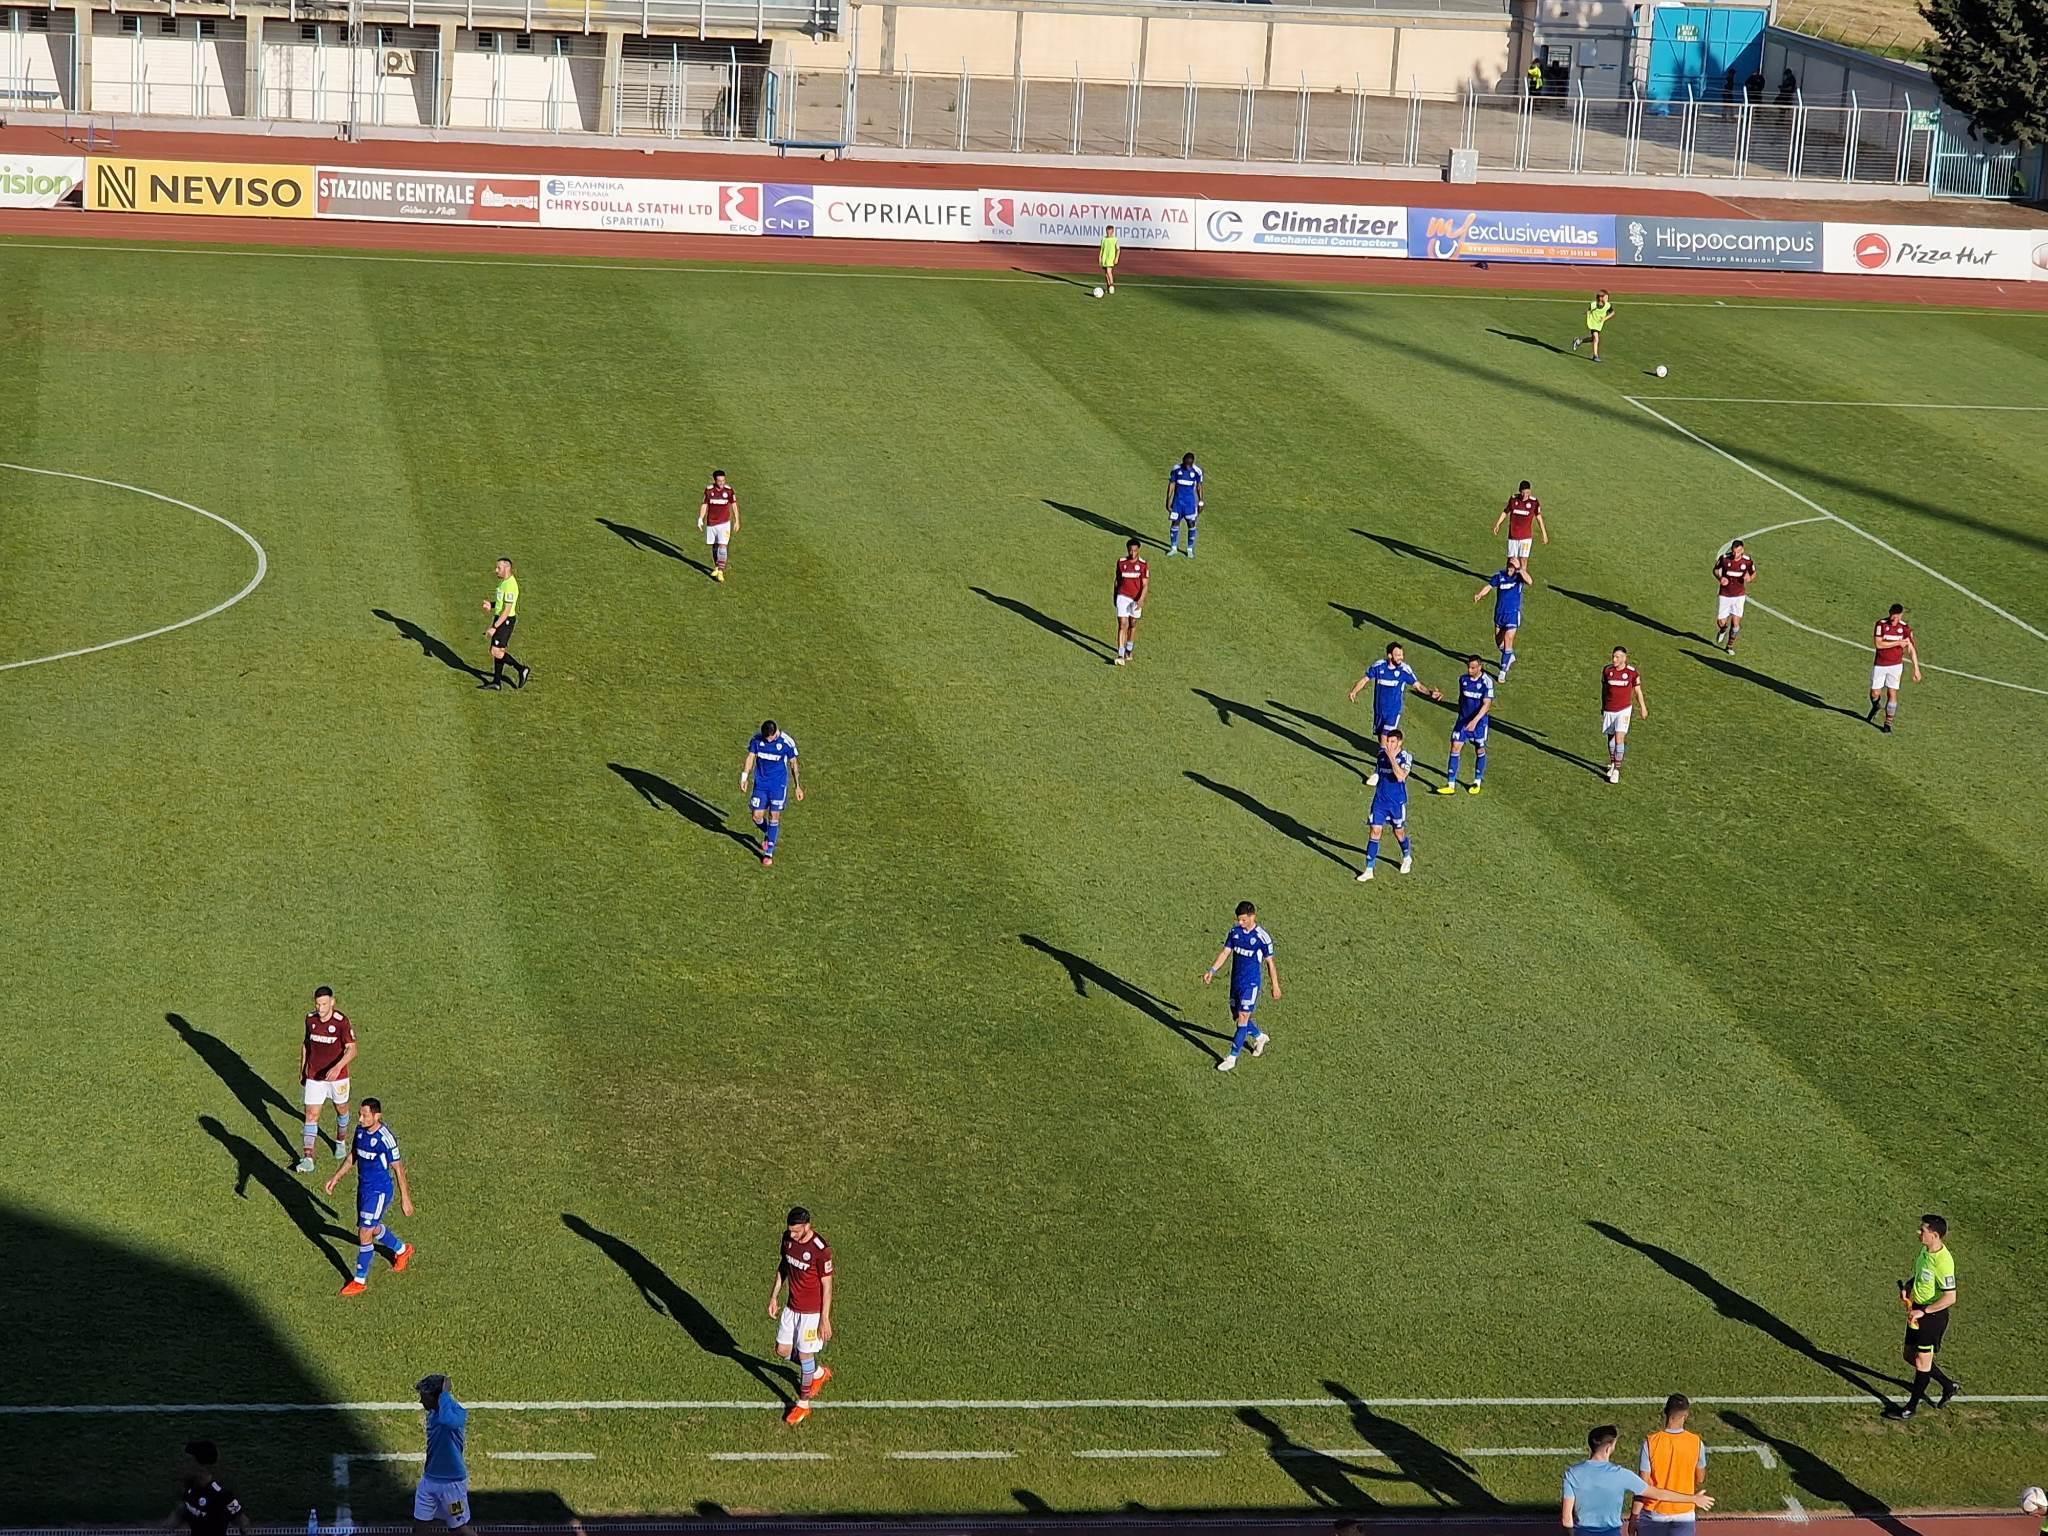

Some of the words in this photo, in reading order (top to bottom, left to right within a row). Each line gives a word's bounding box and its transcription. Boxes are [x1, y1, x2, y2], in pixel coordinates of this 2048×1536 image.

[0, 166, 72, 195] ision
[567, 180, 625, 191] ΕΛΛΗΝΙΚΑ
[150, 174, 302, 208] NEVISO
[319, 177, 393, 201] STAZIONE
[396, 182, 475, 205] CENTRALE
[546, 199, 633, 213] CHRYSOULLA
[638, 202, 684, 215] STATHI
[688, 204, 713, 216] LTD
[828, 201, 972, 227] CYPRIALIFE
[1020, 202, 1065, 218] Α/ΦΟΙ
[1069, 204, 1153, 222] ΑΡΤΥΜΑΤΑ
[1160, 208, 1189, 223] ΛΤΔ
[601, 215, 665, 229] (SPARTIATI)
[729, 224, 757, 232] EKO
[764, 217, 810, 231] CNP
[1262, 210, 1399, 236] Climatizer
[991, 228, 1013, 236] EKO
[1263, 234, 1328, 245] Mechanical
[1330, 237, 1399, 248] Contractors
[1656, 227, 1815, 255] Hippocampus
[1696, 254, 1727, 262] Lounge
[1730, 255, 1775, 264] Restaurant
[1896, 242, 1953, 265] Pizza
[1956, 246, 1998, 265] Hut
